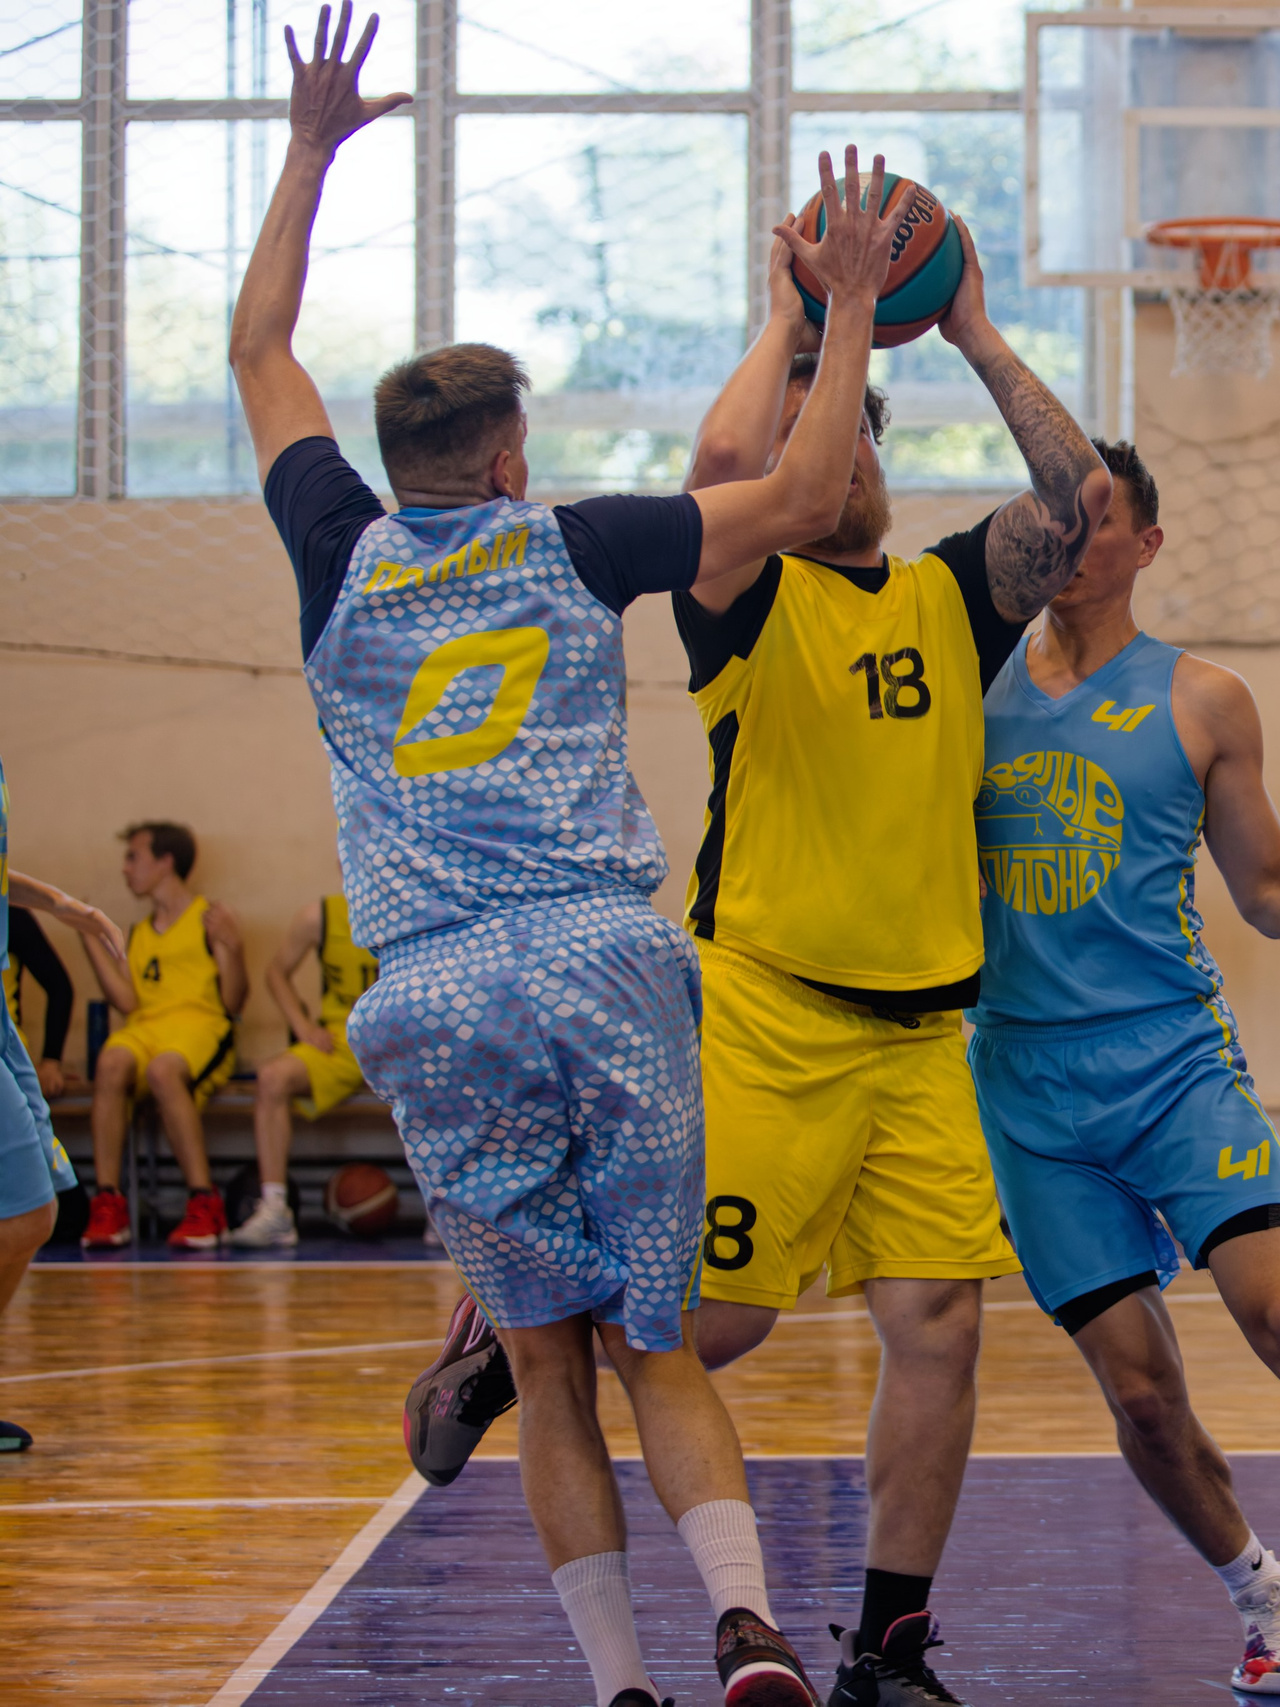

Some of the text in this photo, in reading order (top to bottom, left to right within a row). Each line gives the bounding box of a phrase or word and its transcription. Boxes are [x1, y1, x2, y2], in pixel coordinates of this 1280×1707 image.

[848, 646, 932, 720] 18
[1091, 700, 1156, 732] 41
[143, 956, 161, 982] 4
[1218, 1139, 1270, 1180] 41
